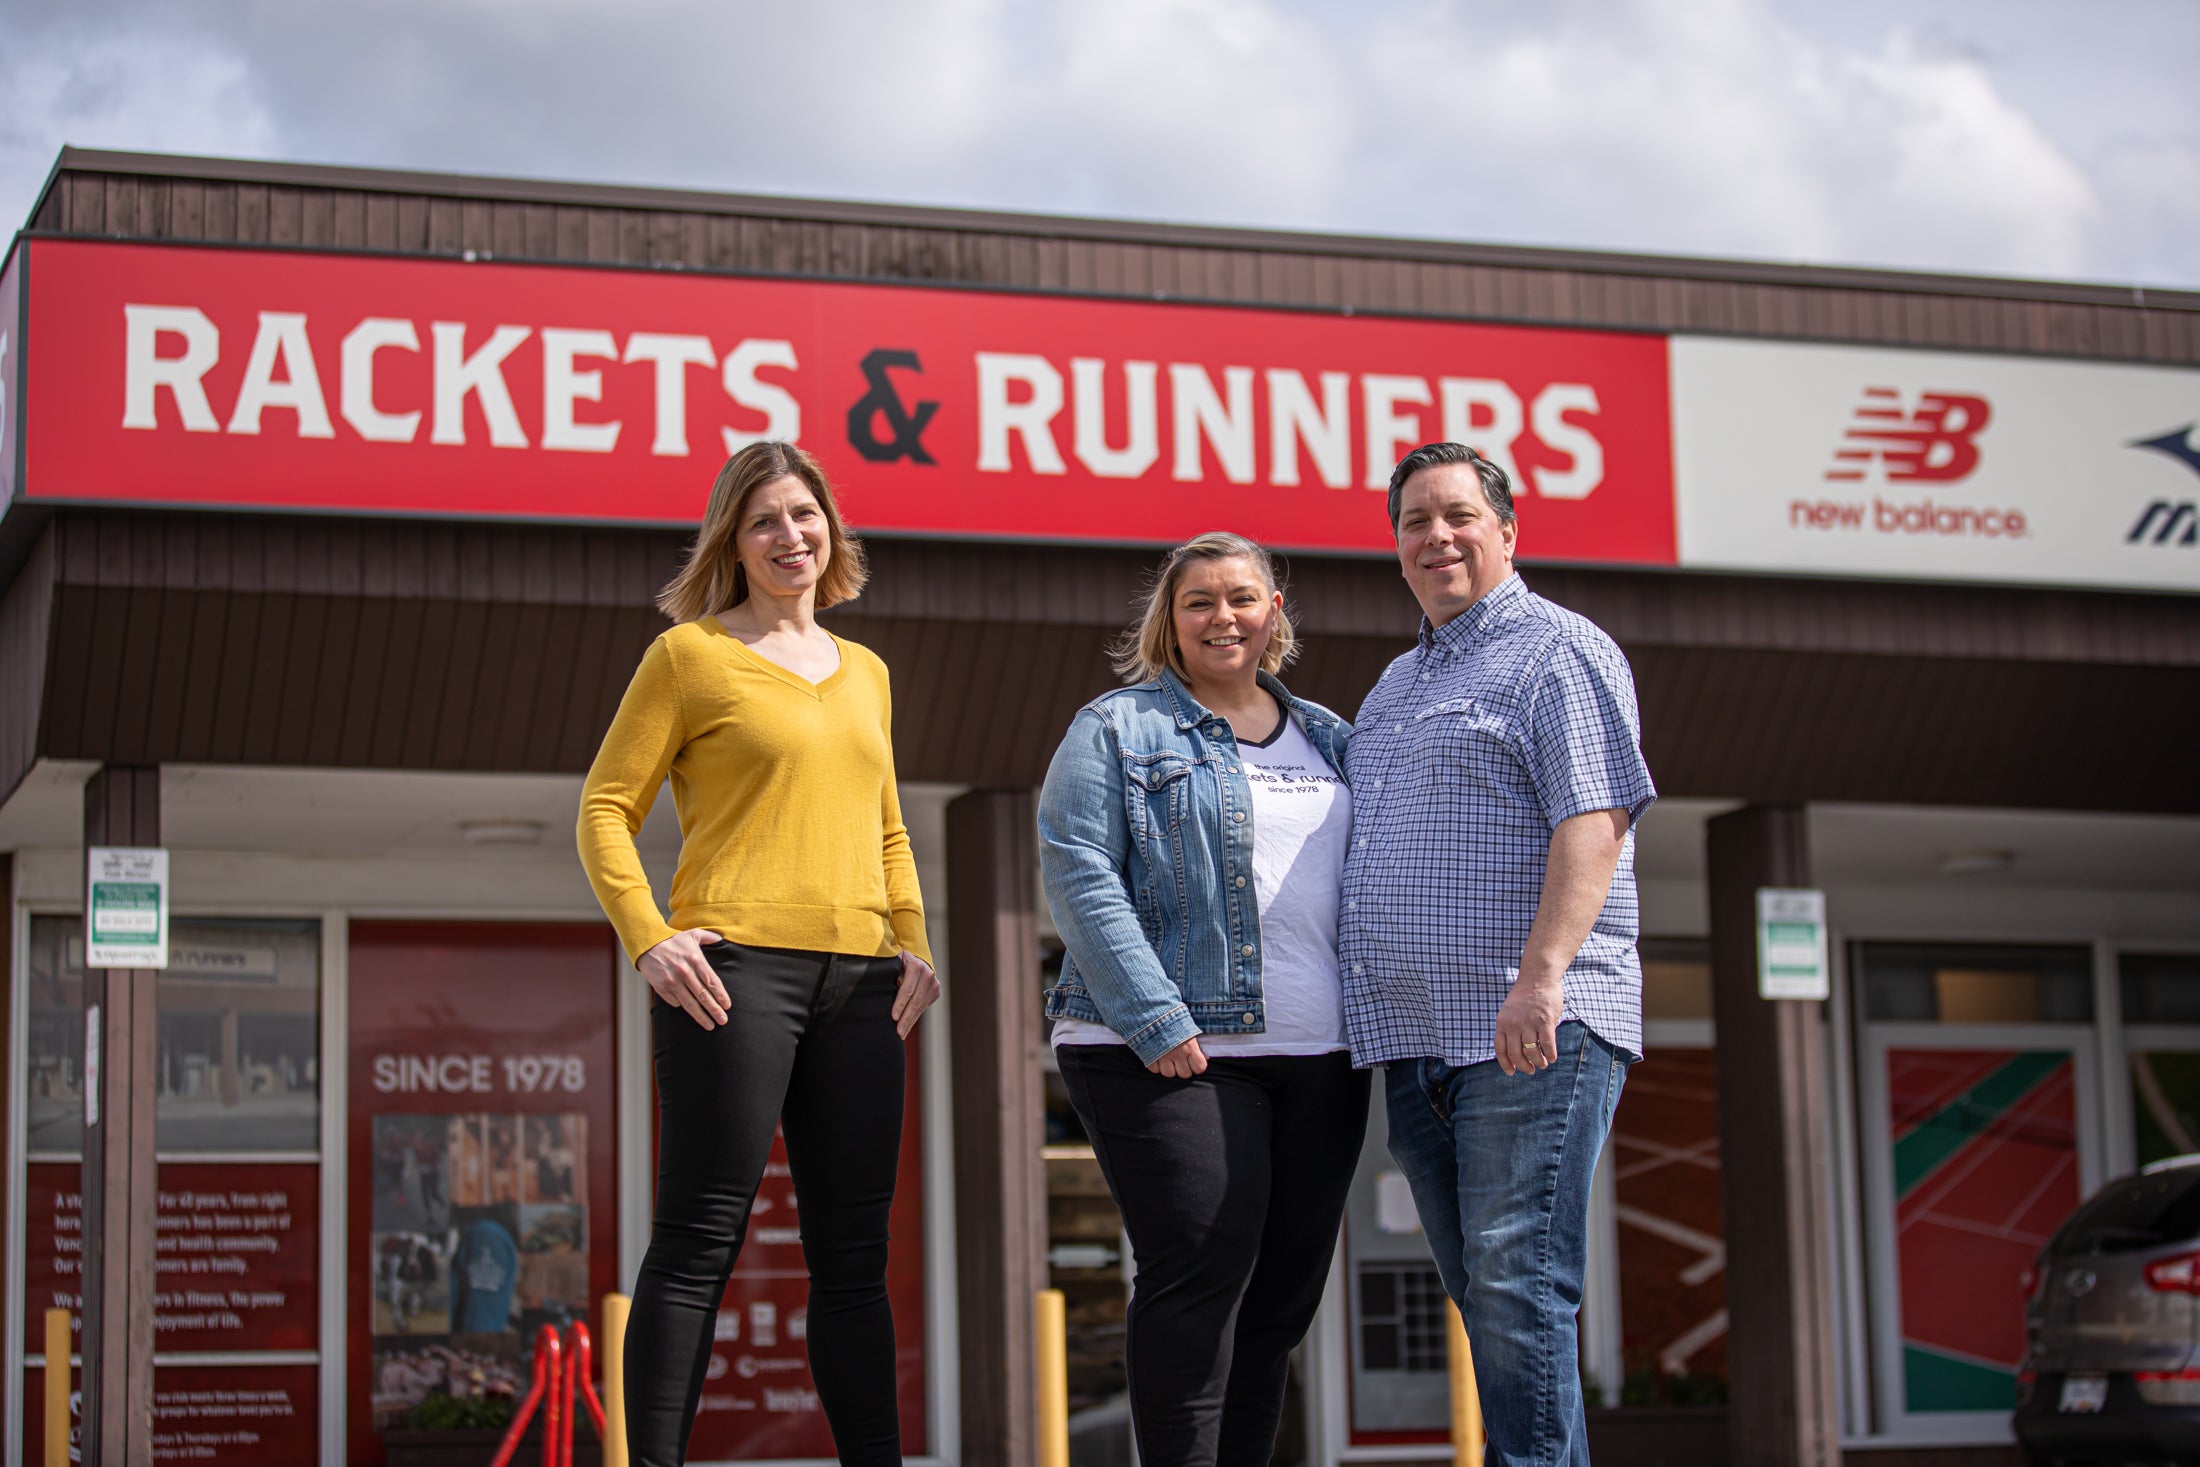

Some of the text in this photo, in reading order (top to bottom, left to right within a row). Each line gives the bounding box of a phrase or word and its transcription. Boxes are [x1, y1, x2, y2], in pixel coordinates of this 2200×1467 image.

[122, 302, 802, 458] RACKETS
[846, 348, 942, 466] &
[974, 350, 1604, 500] RUNNERS
[1790, 495, 2027, 539] new balance
[1254, 763, 1306, 772] the original
[1281, 773, 1295, 784] &
[1267, 785, 1319, 794] since 1978
[373, 1054, 586, 1093] SINCE 1978
[178, 1235, 213, 1251] health
